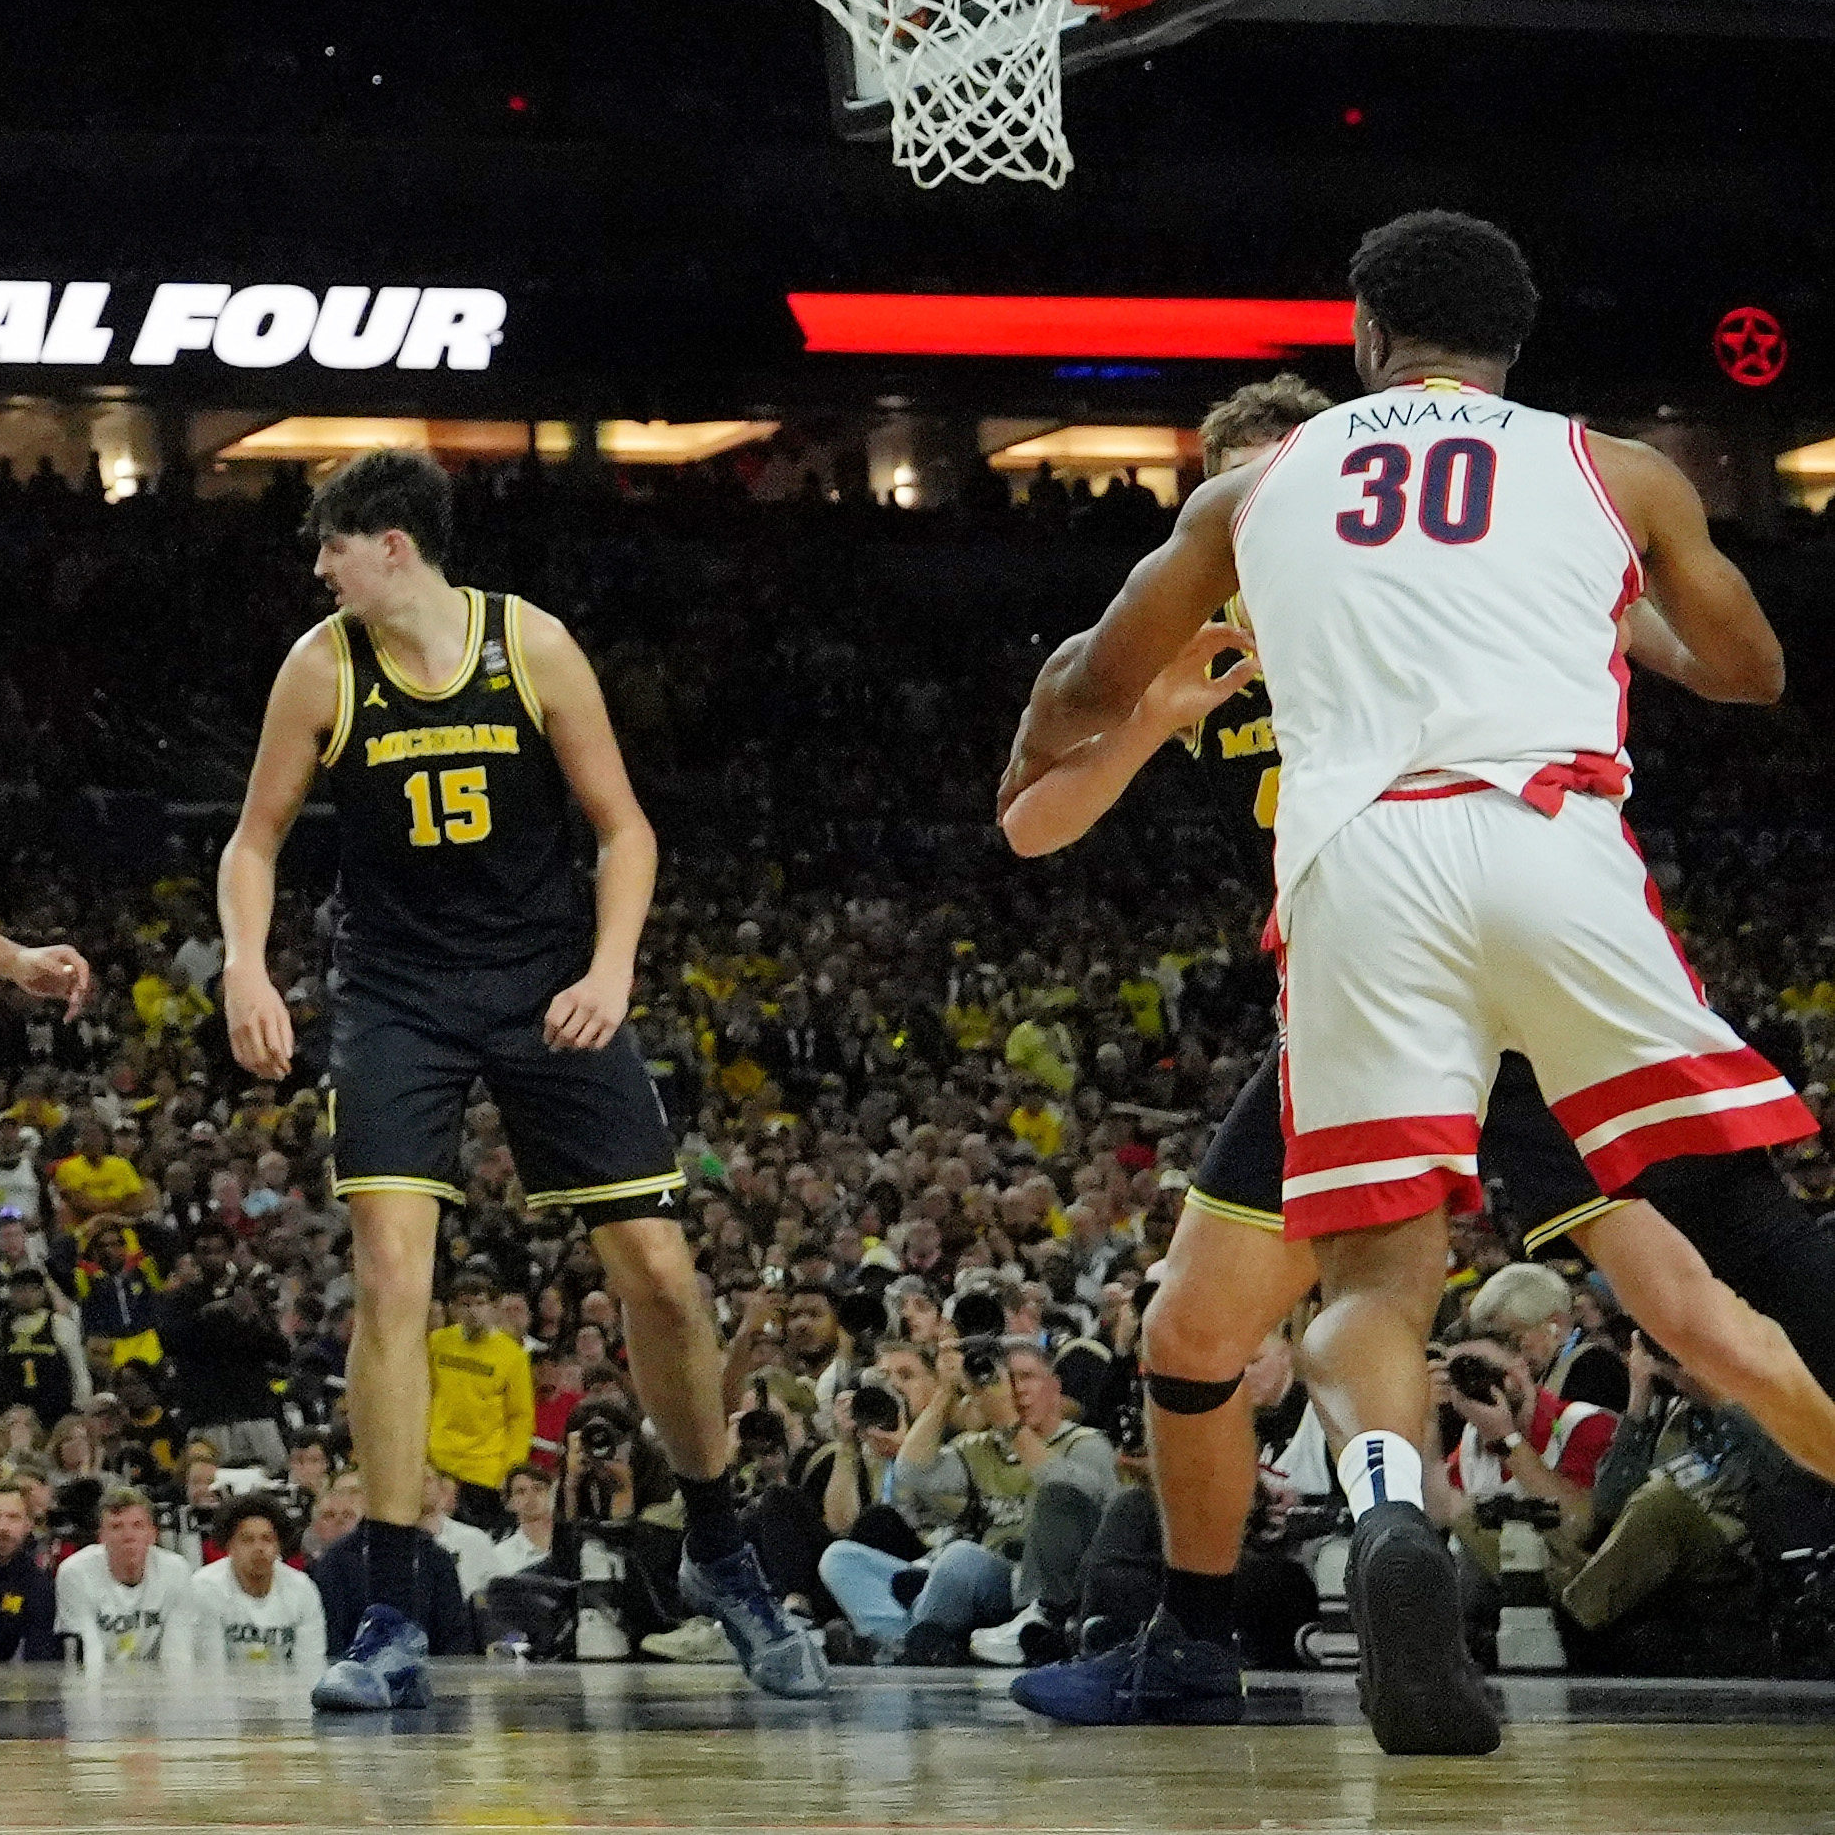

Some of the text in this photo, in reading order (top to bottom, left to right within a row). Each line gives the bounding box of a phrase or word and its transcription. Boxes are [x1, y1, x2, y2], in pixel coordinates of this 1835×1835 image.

[129, 281, 505, 372] FOUR
[1345, 399, 1517, 441] AWAKA
[1335, 436, 1498, 547] 30
[364, 723, 520, 767] MICHIGAN
[403, 765, 492, 849] 15
